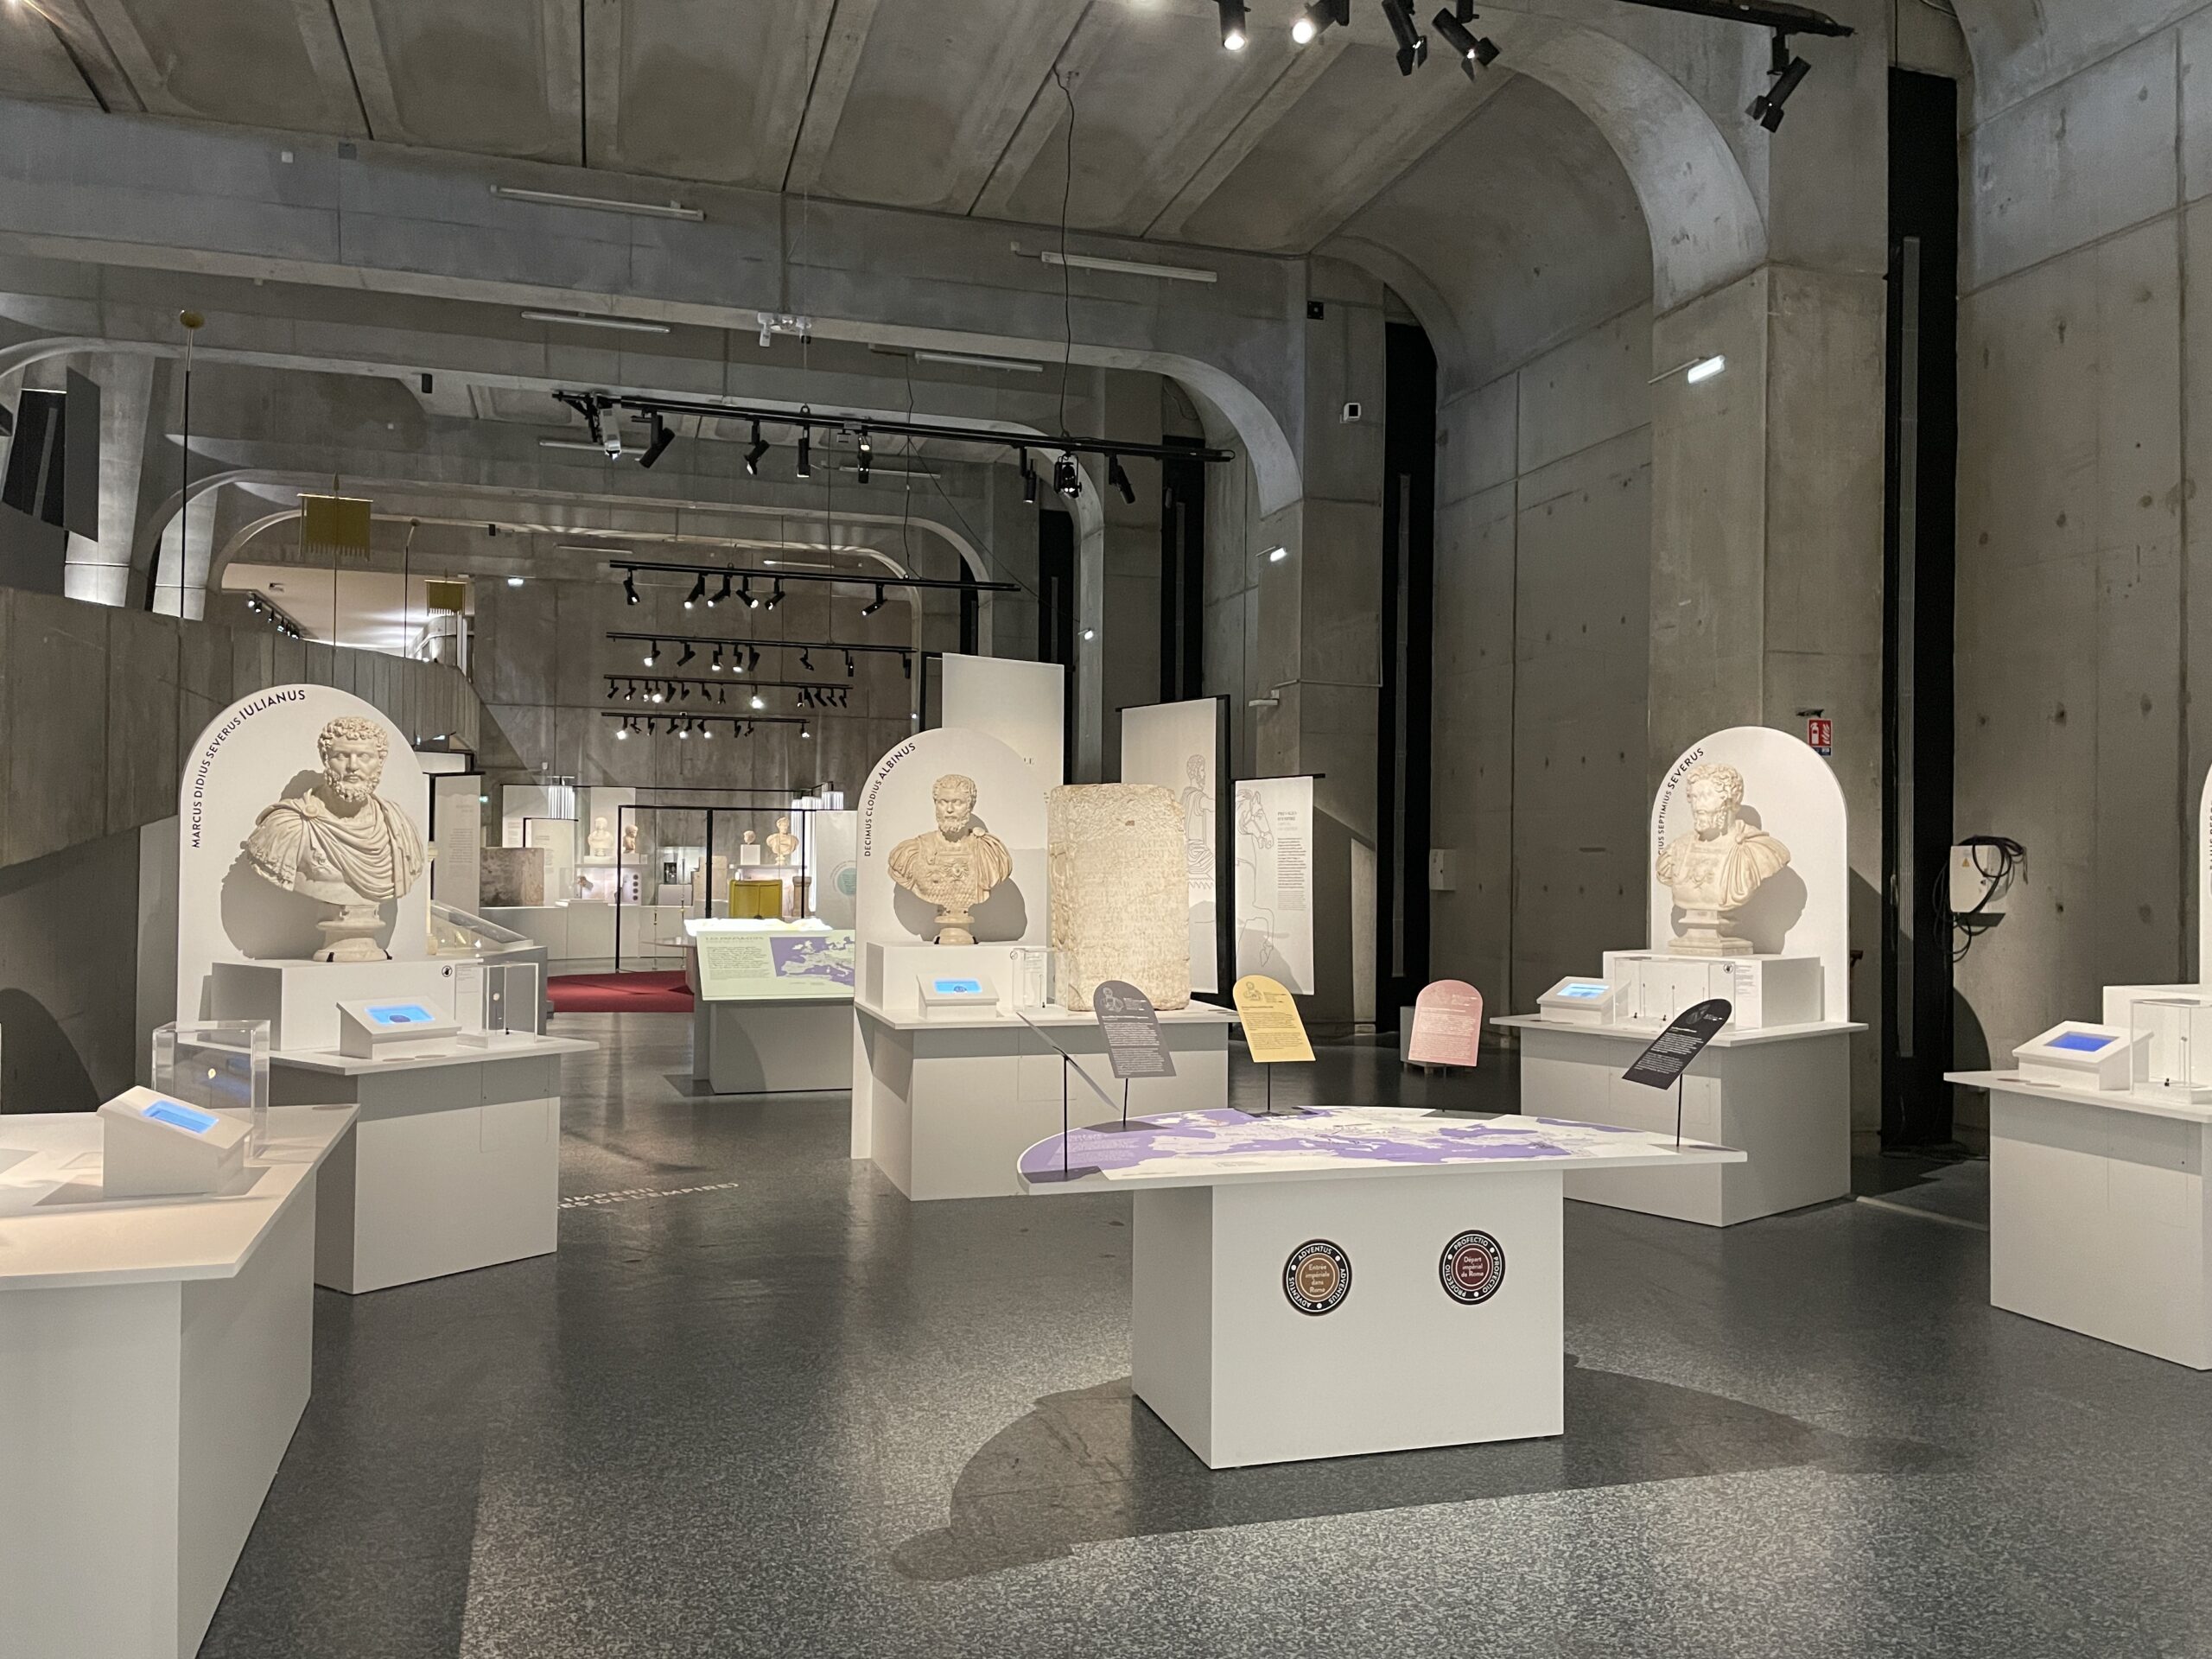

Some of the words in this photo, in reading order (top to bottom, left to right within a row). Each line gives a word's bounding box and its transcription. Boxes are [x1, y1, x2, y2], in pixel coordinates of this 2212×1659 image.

[238, 690, 306, 720] IULIANUS
[206, 717, 241, 759] SEVERUS
[194, 760, 211, 798] DIDIUS
[866, 779, 881, 817] CLODIUS
[878, 742, 916, 779] ALBINUS
[1657, 790, 1672, 835] SEPTIMIUS
[1667, 747, 1704, 790] SEVERUS
[192, 801, 201, 848] MARCUS
[1298, 1245, 1332, 1262] ADVENTUS
[1453, 1236, 1489, 1250] PROFECTIO
[1288, 1277, 1312, 1308] ADVENTUS
[1327, 1268, 1347, 1304] ADVENTUS
[1445, 1264, 1467, 1297] PROFECTIO
[1483, 1255, 1500, 1294] PROFECTIO
